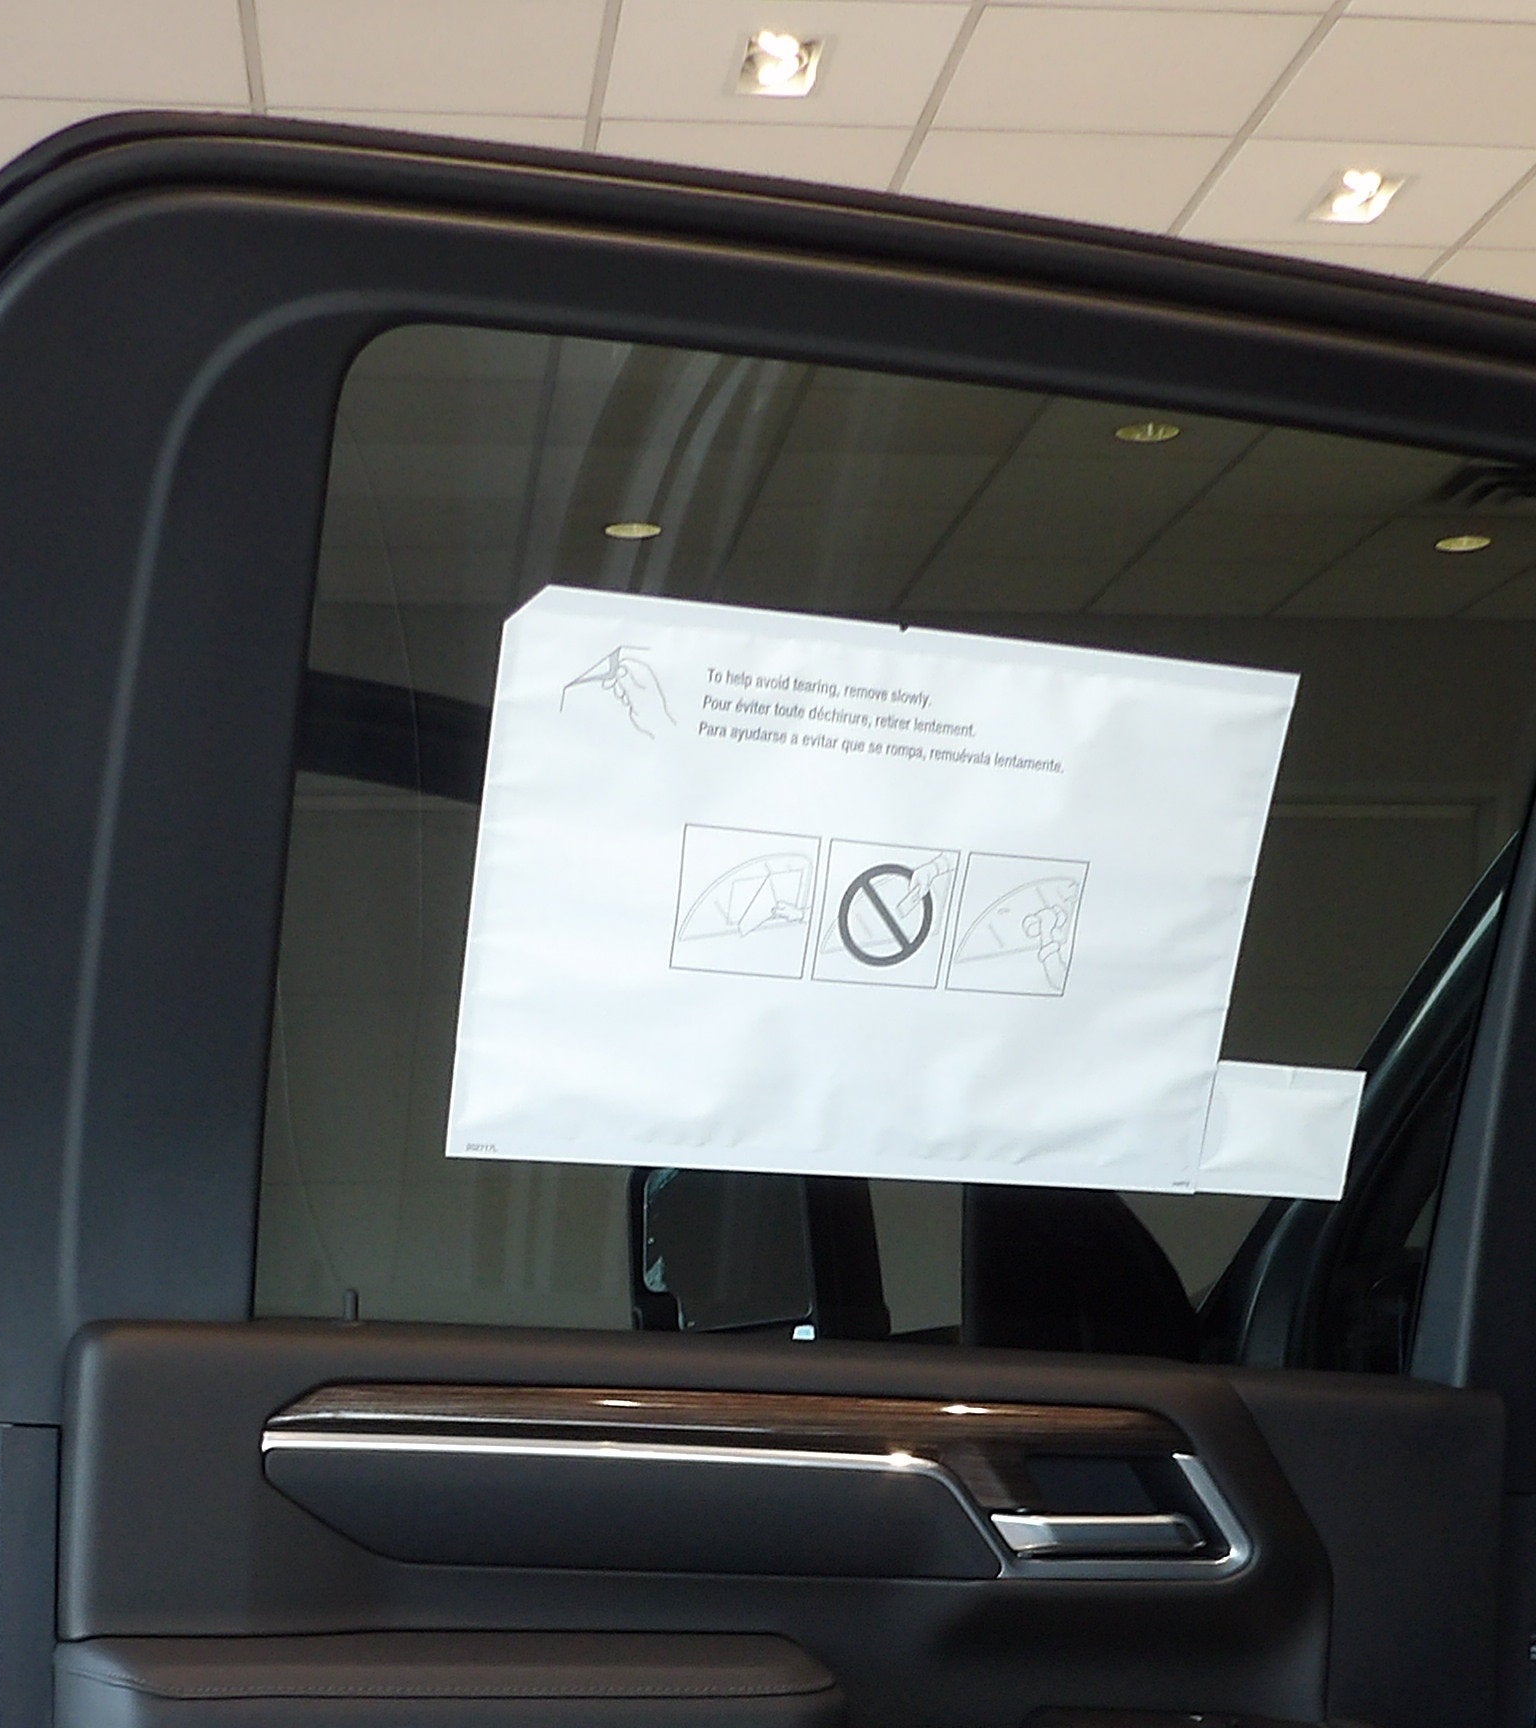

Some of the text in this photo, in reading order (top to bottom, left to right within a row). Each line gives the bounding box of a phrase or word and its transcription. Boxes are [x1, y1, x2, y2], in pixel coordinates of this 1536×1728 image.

[706, 668, 932, 709] To help avoid tearing, remove slowly.
[702, 695, 976, 737] Pour éviter toute déchirure, retirer lentement.
[698, 721, 1065, 774] Para ayudarse a evitar que se rompa, remuévala lentamente.
